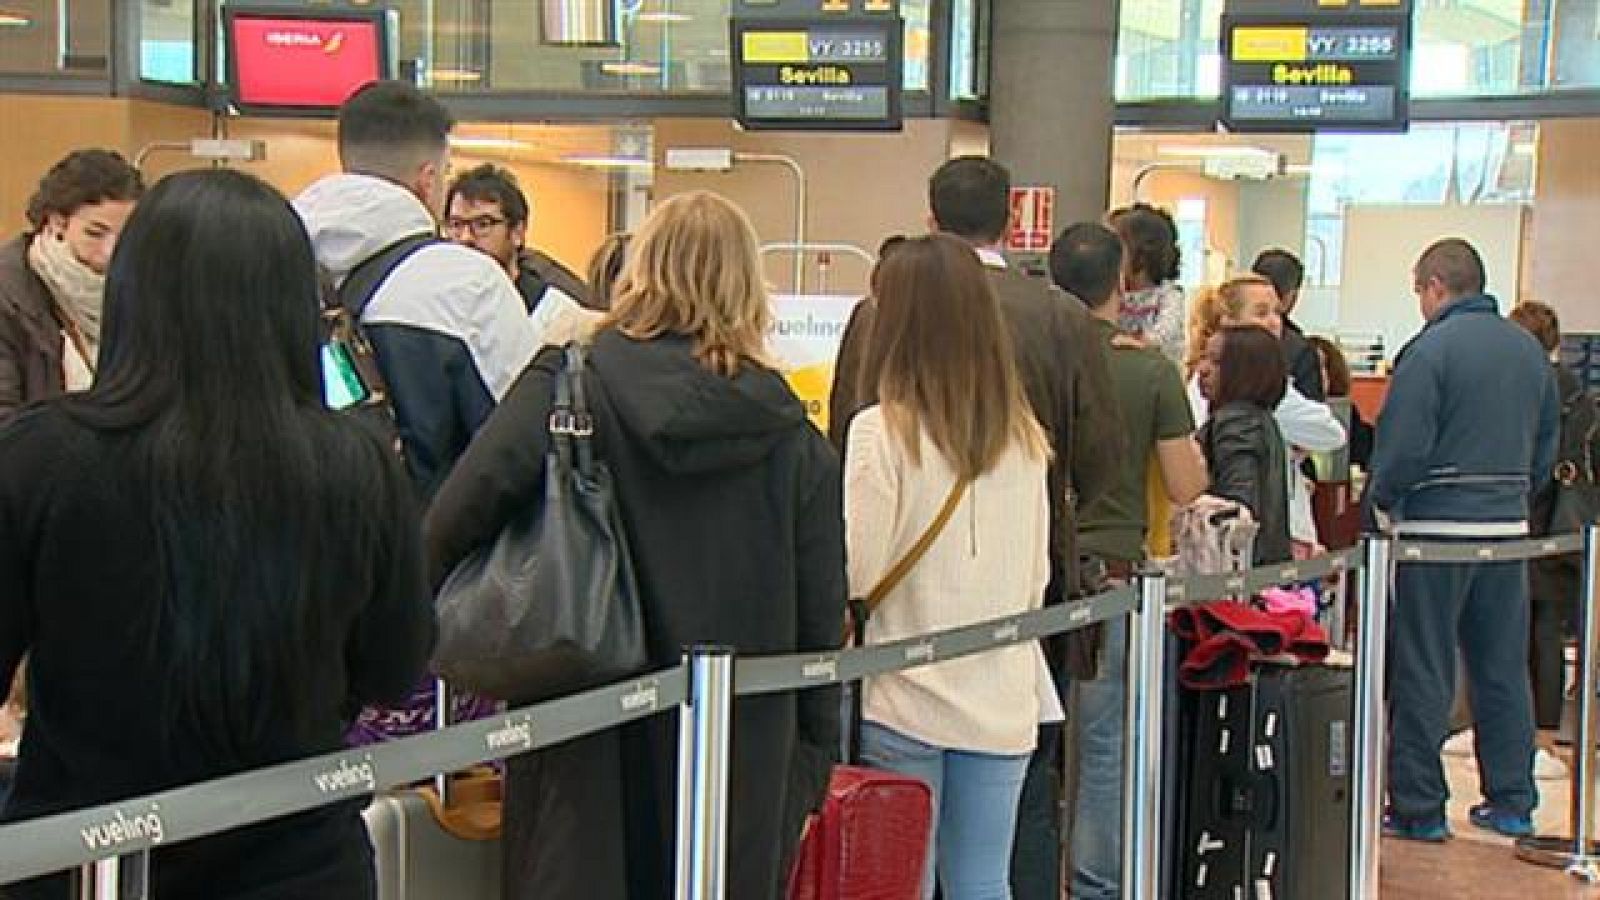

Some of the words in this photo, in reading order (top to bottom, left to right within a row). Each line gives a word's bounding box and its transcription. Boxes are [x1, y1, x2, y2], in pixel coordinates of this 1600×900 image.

[810, 40, 835, 56] VY
[1309, 36, 1336, 52] VY
[779, 66, 849, 84] Sevilla
[1272, 65, 1352, 84] Sevilla
[486, 714, 531, 749] vueling
[313, 752, 375, 793] vueling
[80, 803, 164, 851] vueling
